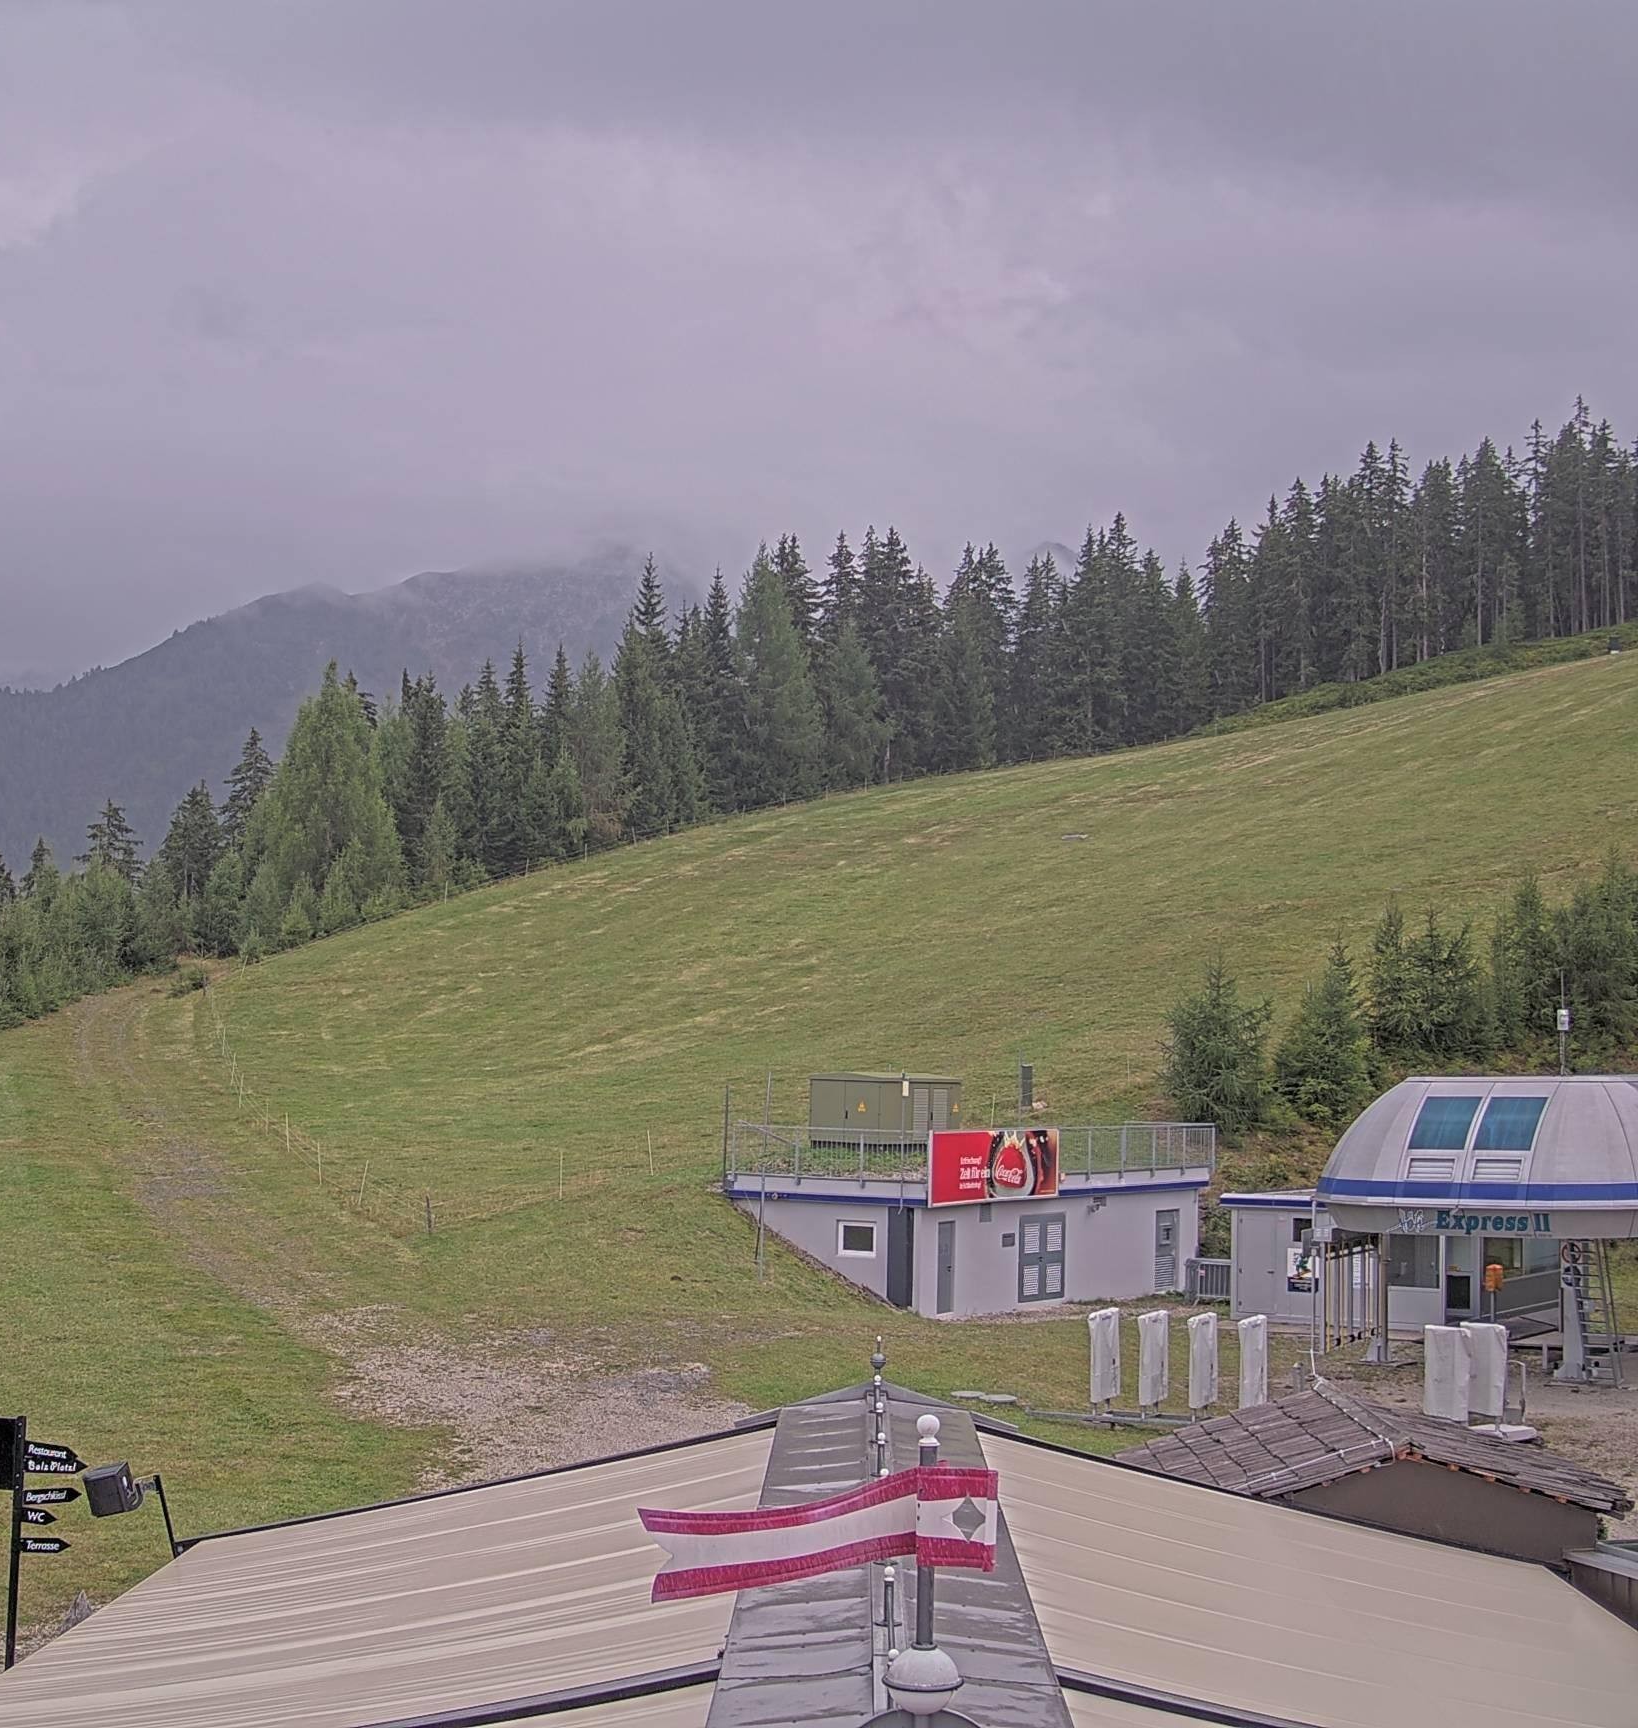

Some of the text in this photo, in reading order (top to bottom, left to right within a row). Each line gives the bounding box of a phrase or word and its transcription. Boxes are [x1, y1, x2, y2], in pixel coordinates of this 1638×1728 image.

[1436, 1210, 1529, 1235] Express
[28, 1444, 67, 1459] Restaurant
[27, 1510, 46, 1522] WC
[26, 1540, 60, 1551] Terrasse
